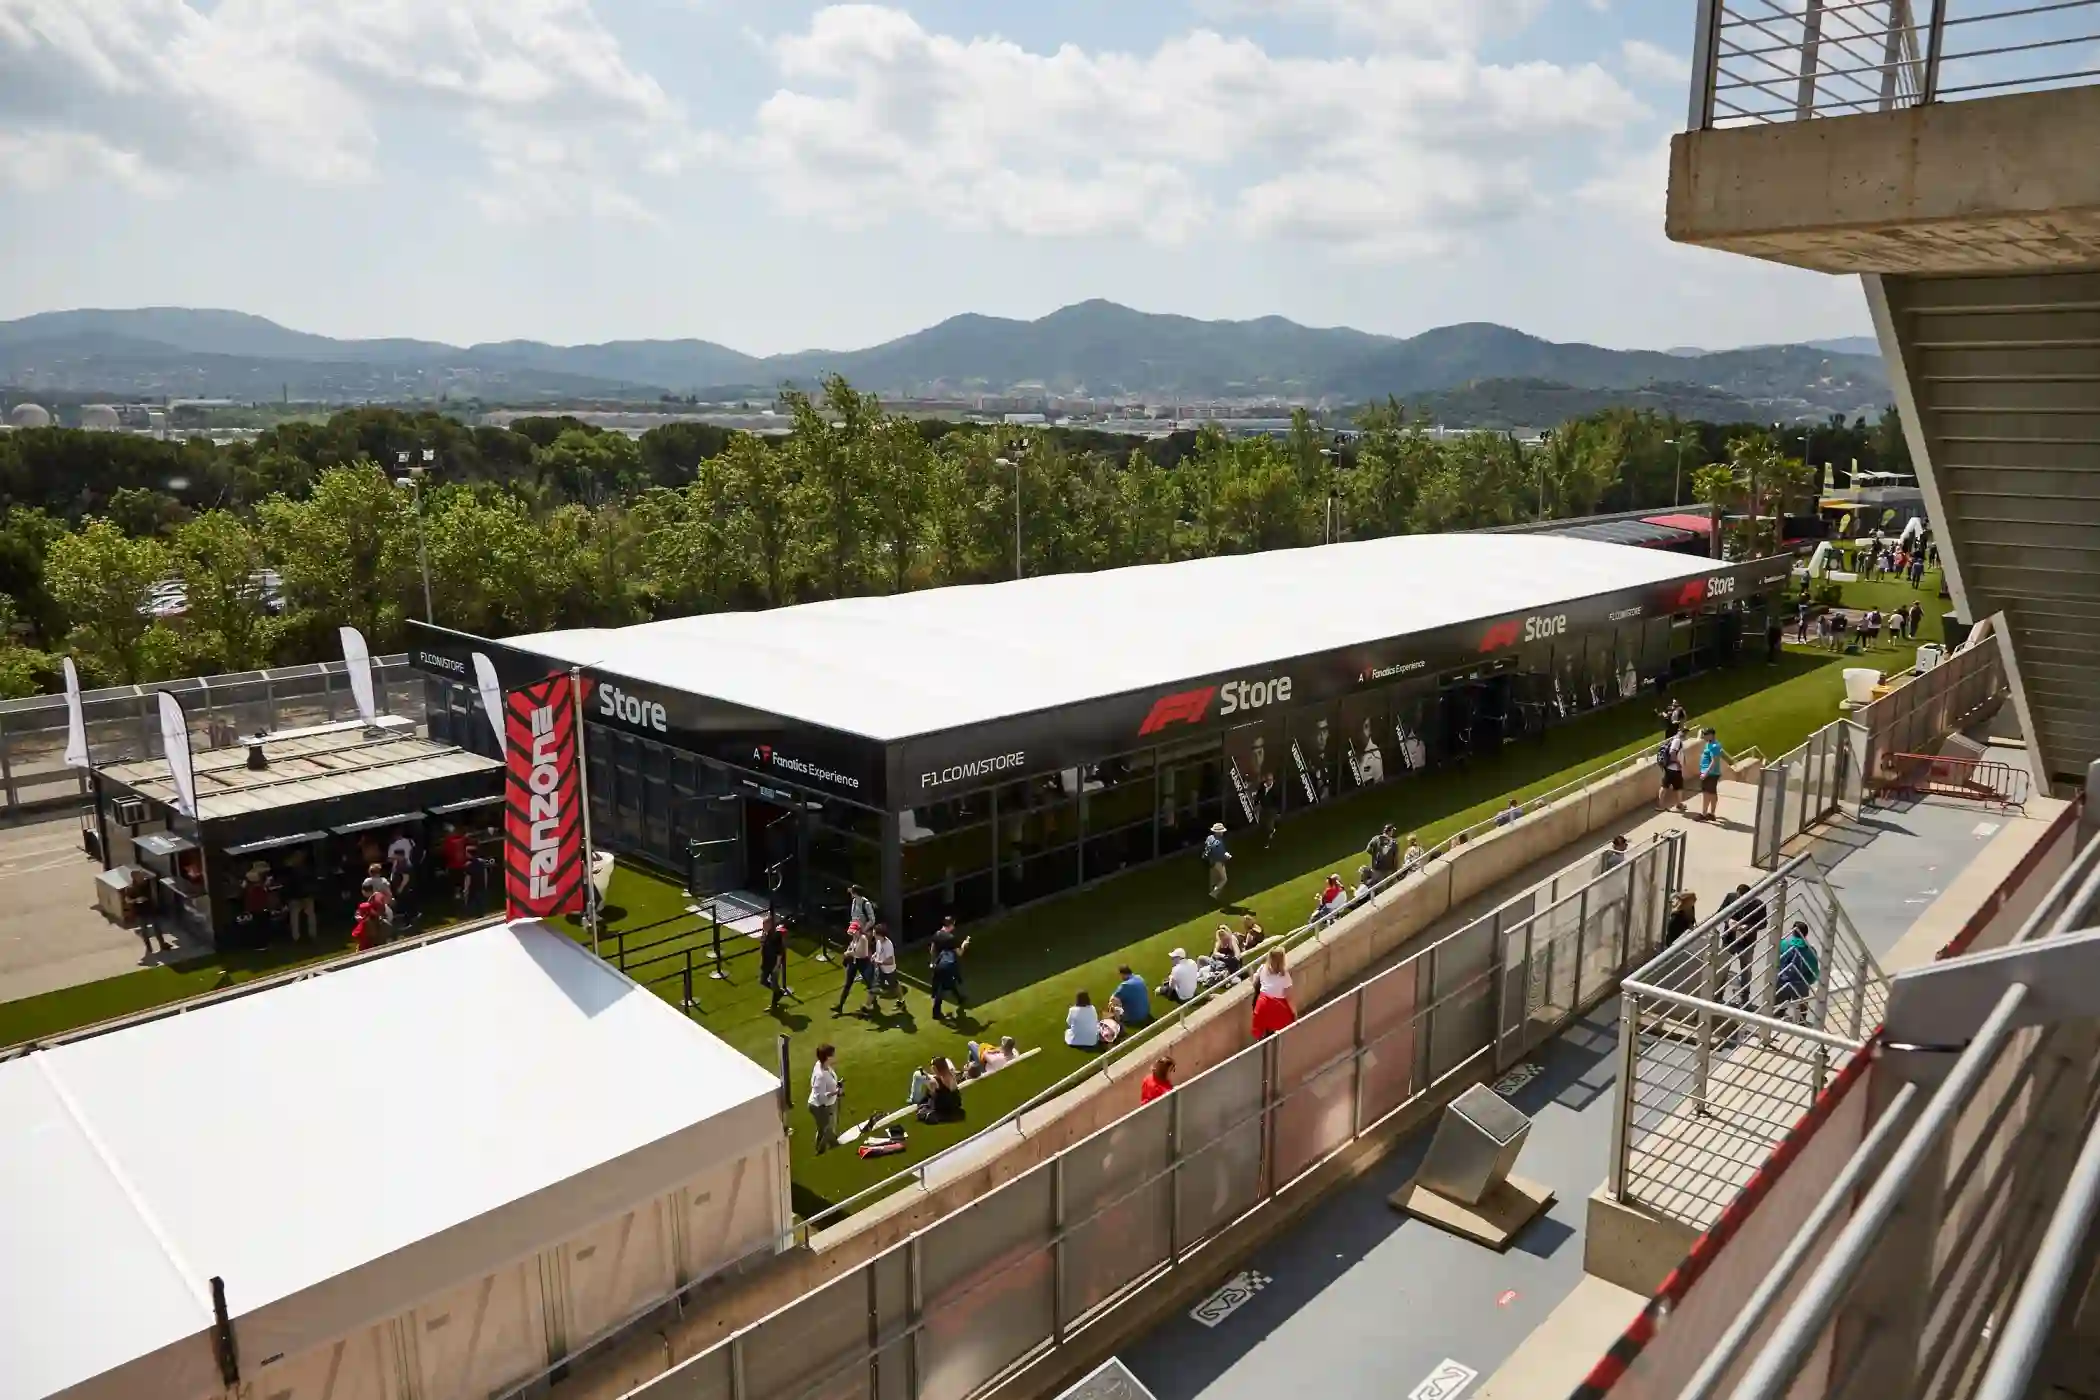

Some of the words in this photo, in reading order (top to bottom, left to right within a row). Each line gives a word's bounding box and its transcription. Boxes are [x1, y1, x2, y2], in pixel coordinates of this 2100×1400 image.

[1707, 577, 1735, 598] Store
[1524, 614, 1567, 642] Store
[1371, 664, 1396, 680] Fanatics
[1395, 659, 1426, 674] Experience
[599, 682, 668, 733] Store
[1220, 676, 1292, 716] Store
[753, 747, 760, 760] A
[772, 751, 808, 774] Fanatics
[808, 763, 859, 789] Experience
[921, 751, 1025, 789] F1.COM/STORE
